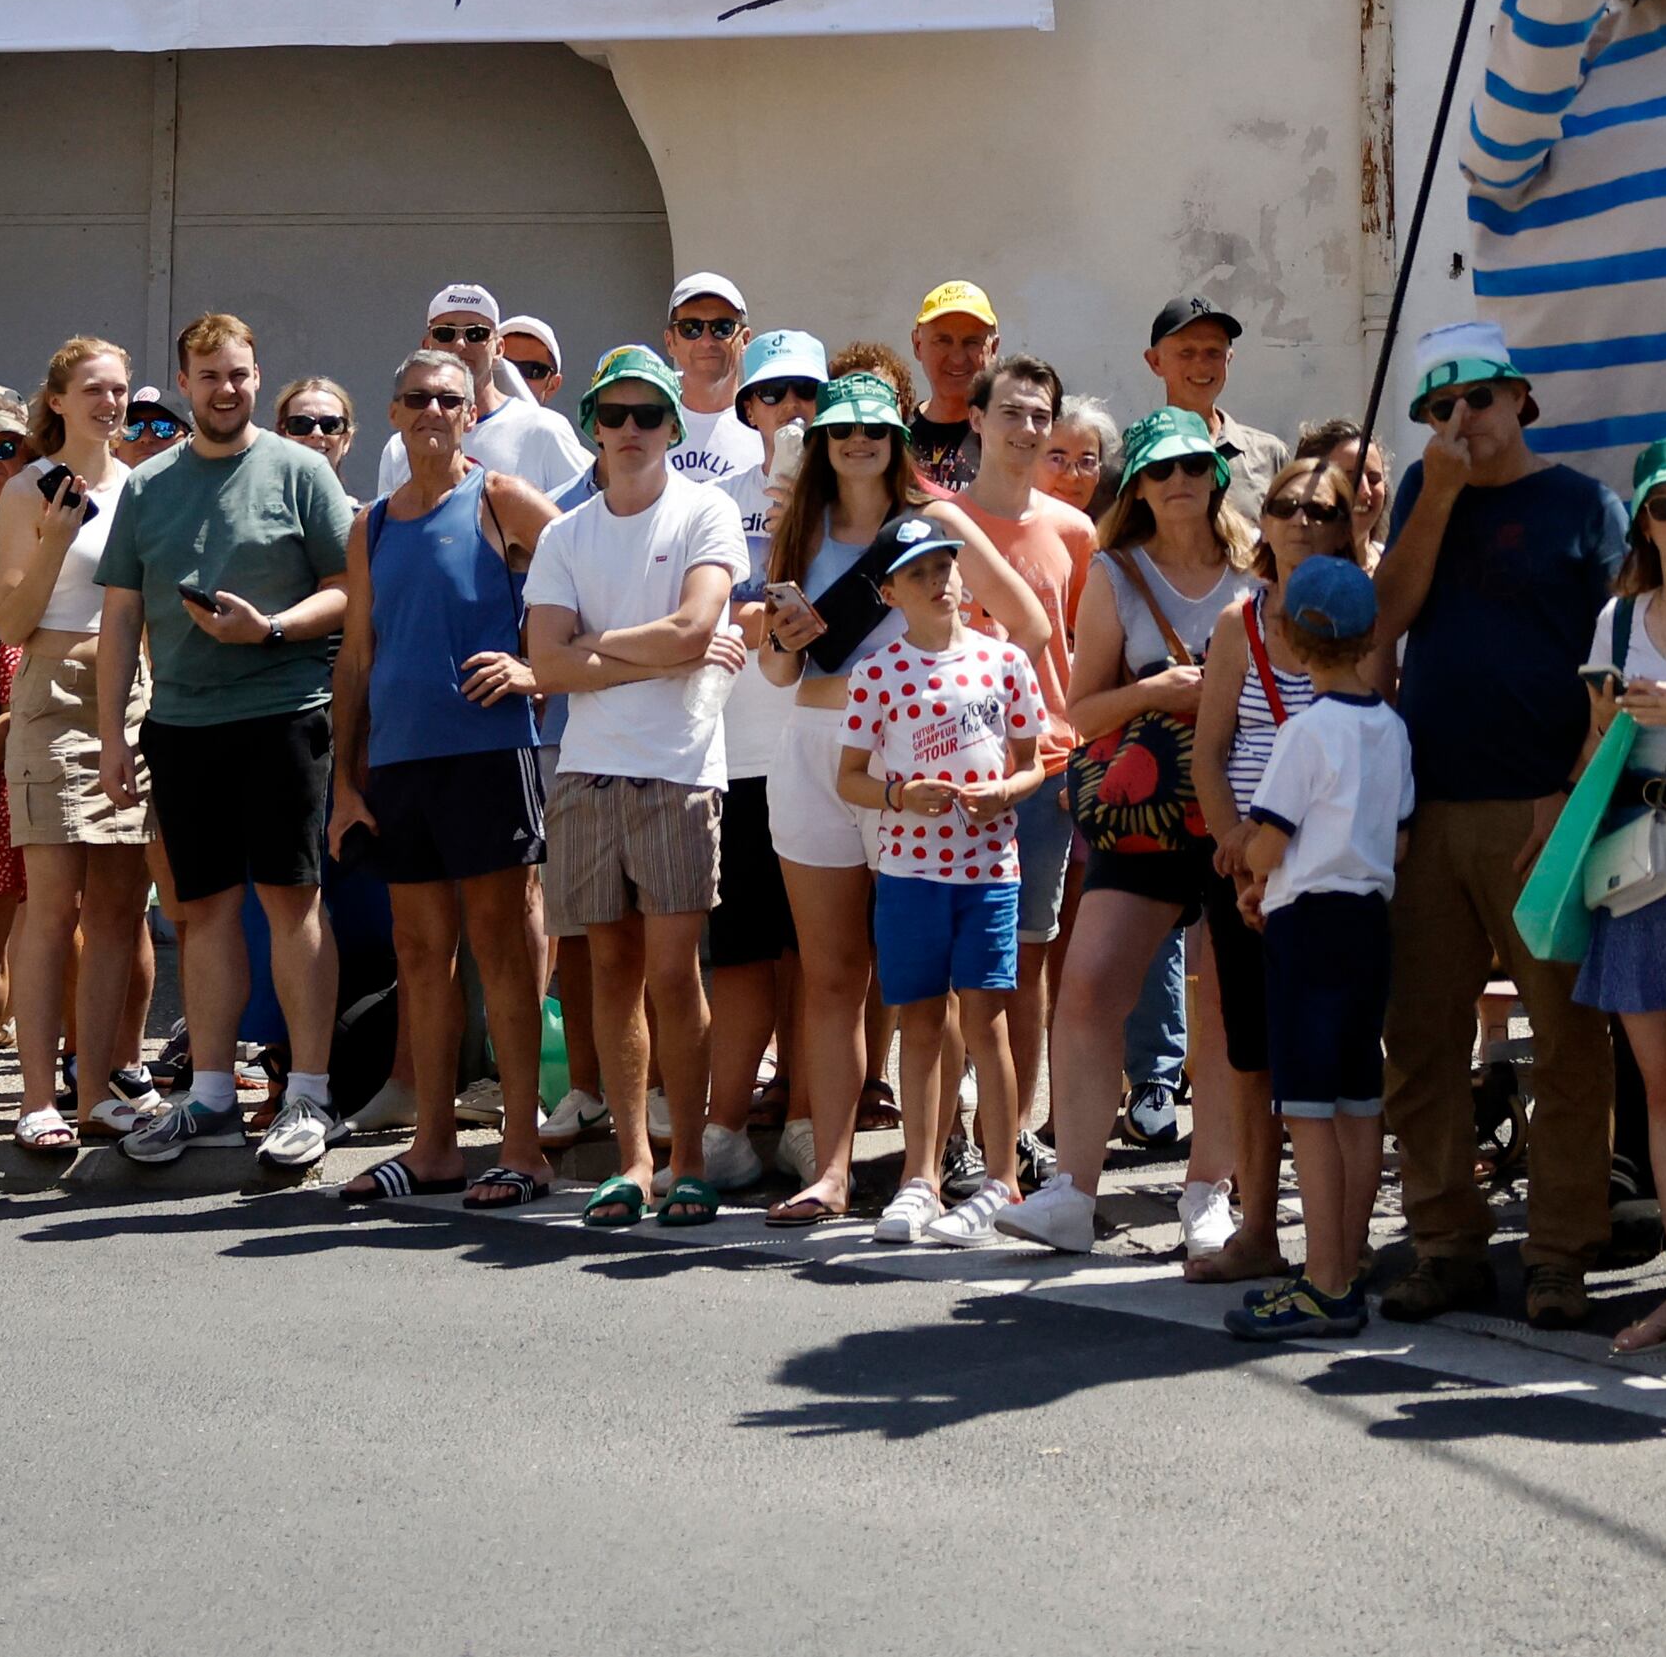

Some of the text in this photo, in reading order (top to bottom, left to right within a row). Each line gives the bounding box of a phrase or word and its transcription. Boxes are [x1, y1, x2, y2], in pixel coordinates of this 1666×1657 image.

[447, 294, 482, 305] Santini
[912, 723, 936, 741] FUTUR
[913, 724, 957, 752] GRIMPEUR
[923, 737, 959, 764] TOUR
